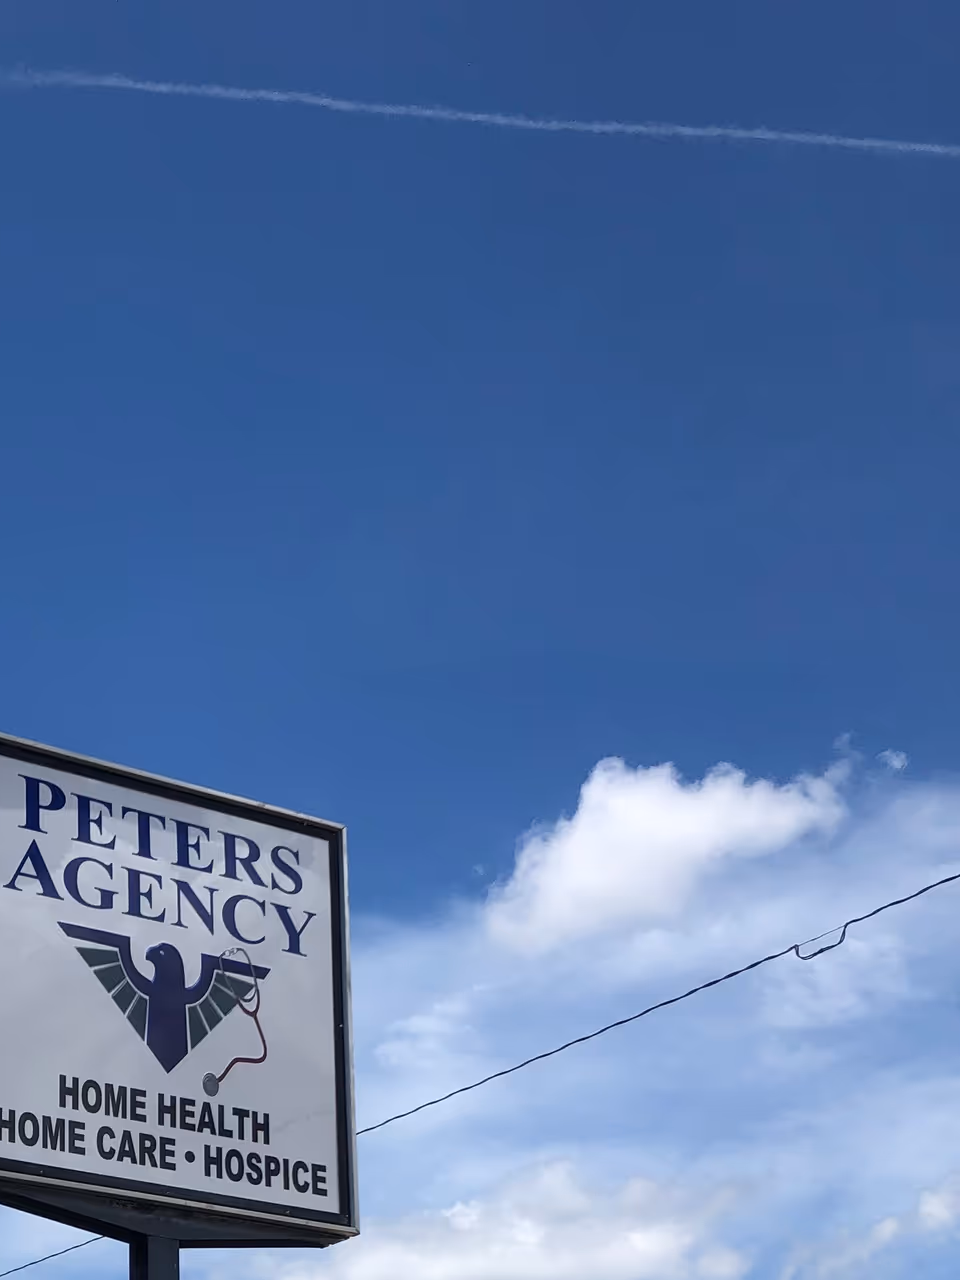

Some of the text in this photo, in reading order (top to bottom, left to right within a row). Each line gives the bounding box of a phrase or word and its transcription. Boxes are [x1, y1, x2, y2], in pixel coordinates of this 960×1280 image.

[17, 773, 303, 895] PETERS
[2, 838, 317, 958] AGENCY
[58, 1074, 270, 1146] HOME HEALTH
[96, 1125, 177, 1172] CARE
[203, 1143, 328, 1197] HOSPICE
